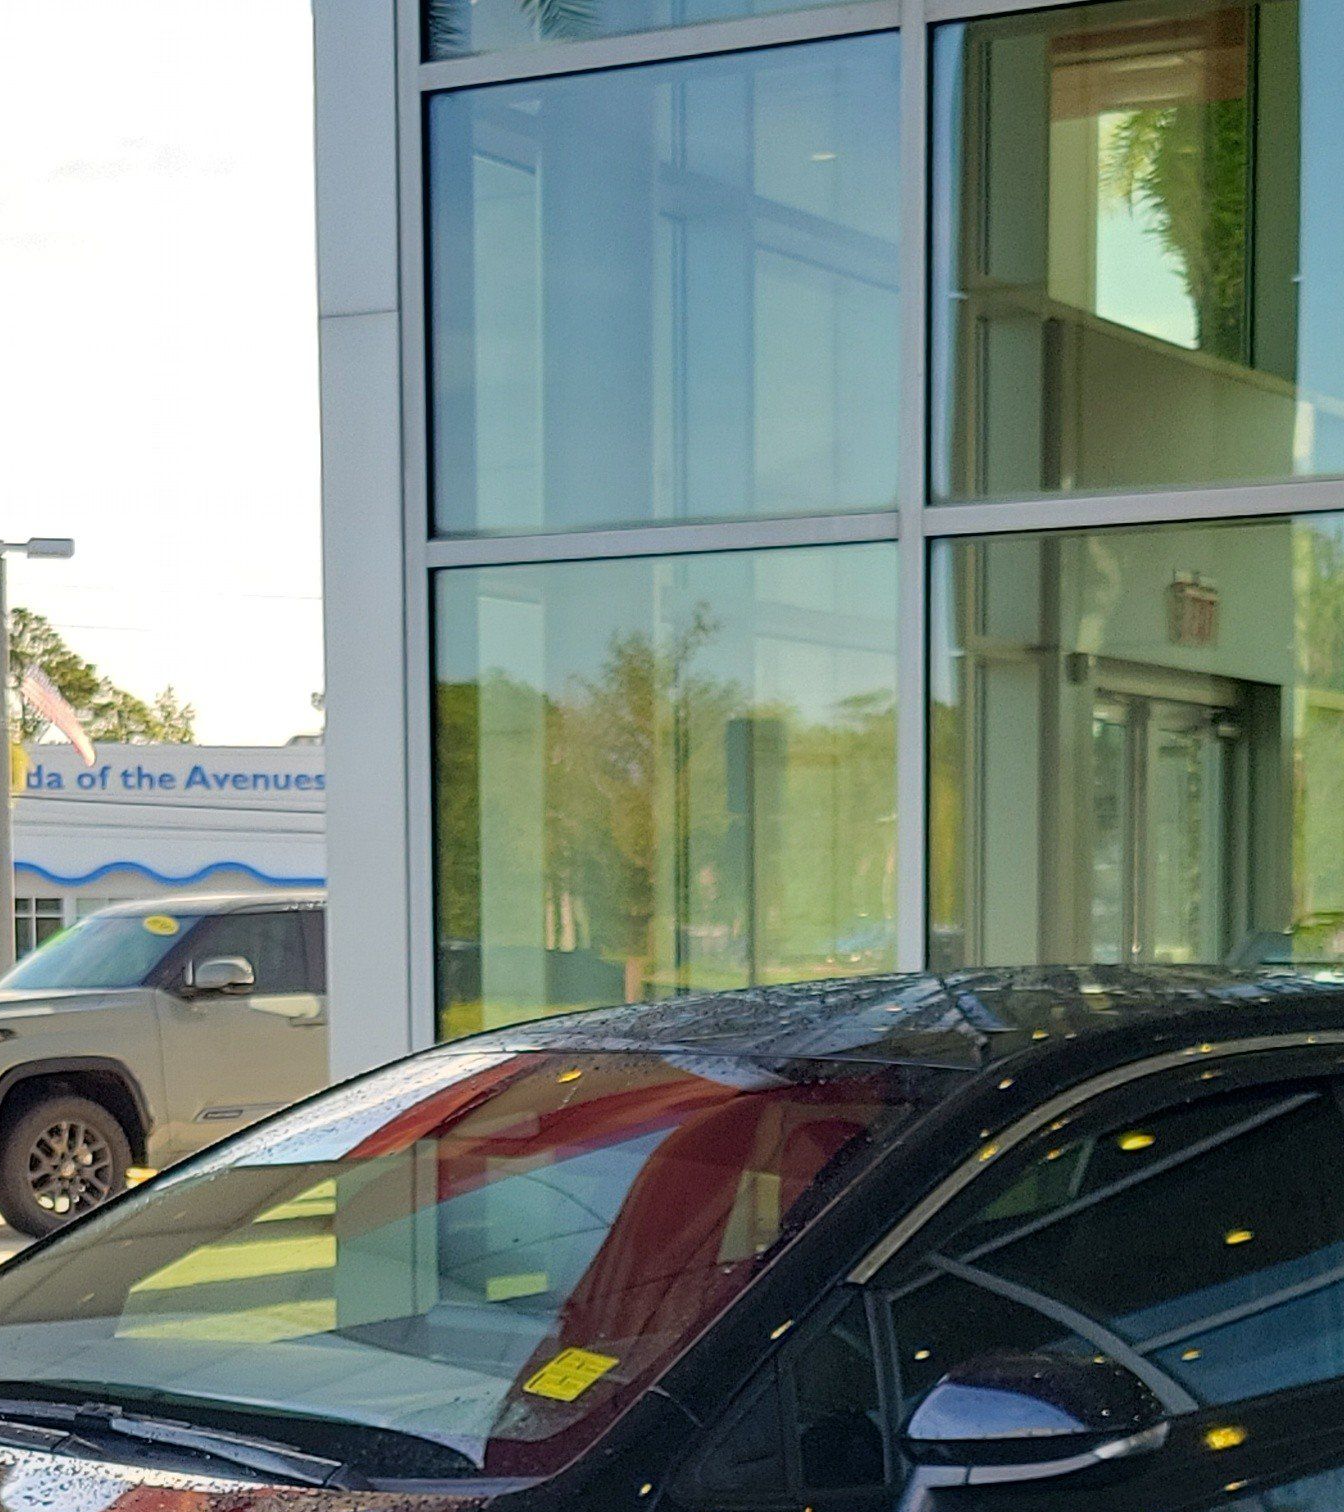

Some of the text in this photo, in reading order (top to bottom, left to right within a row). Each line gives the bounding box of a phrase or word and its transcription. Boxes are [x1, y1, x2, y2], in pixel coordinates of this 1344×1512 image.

[27, 764, 325, 790] da of the Avenues
